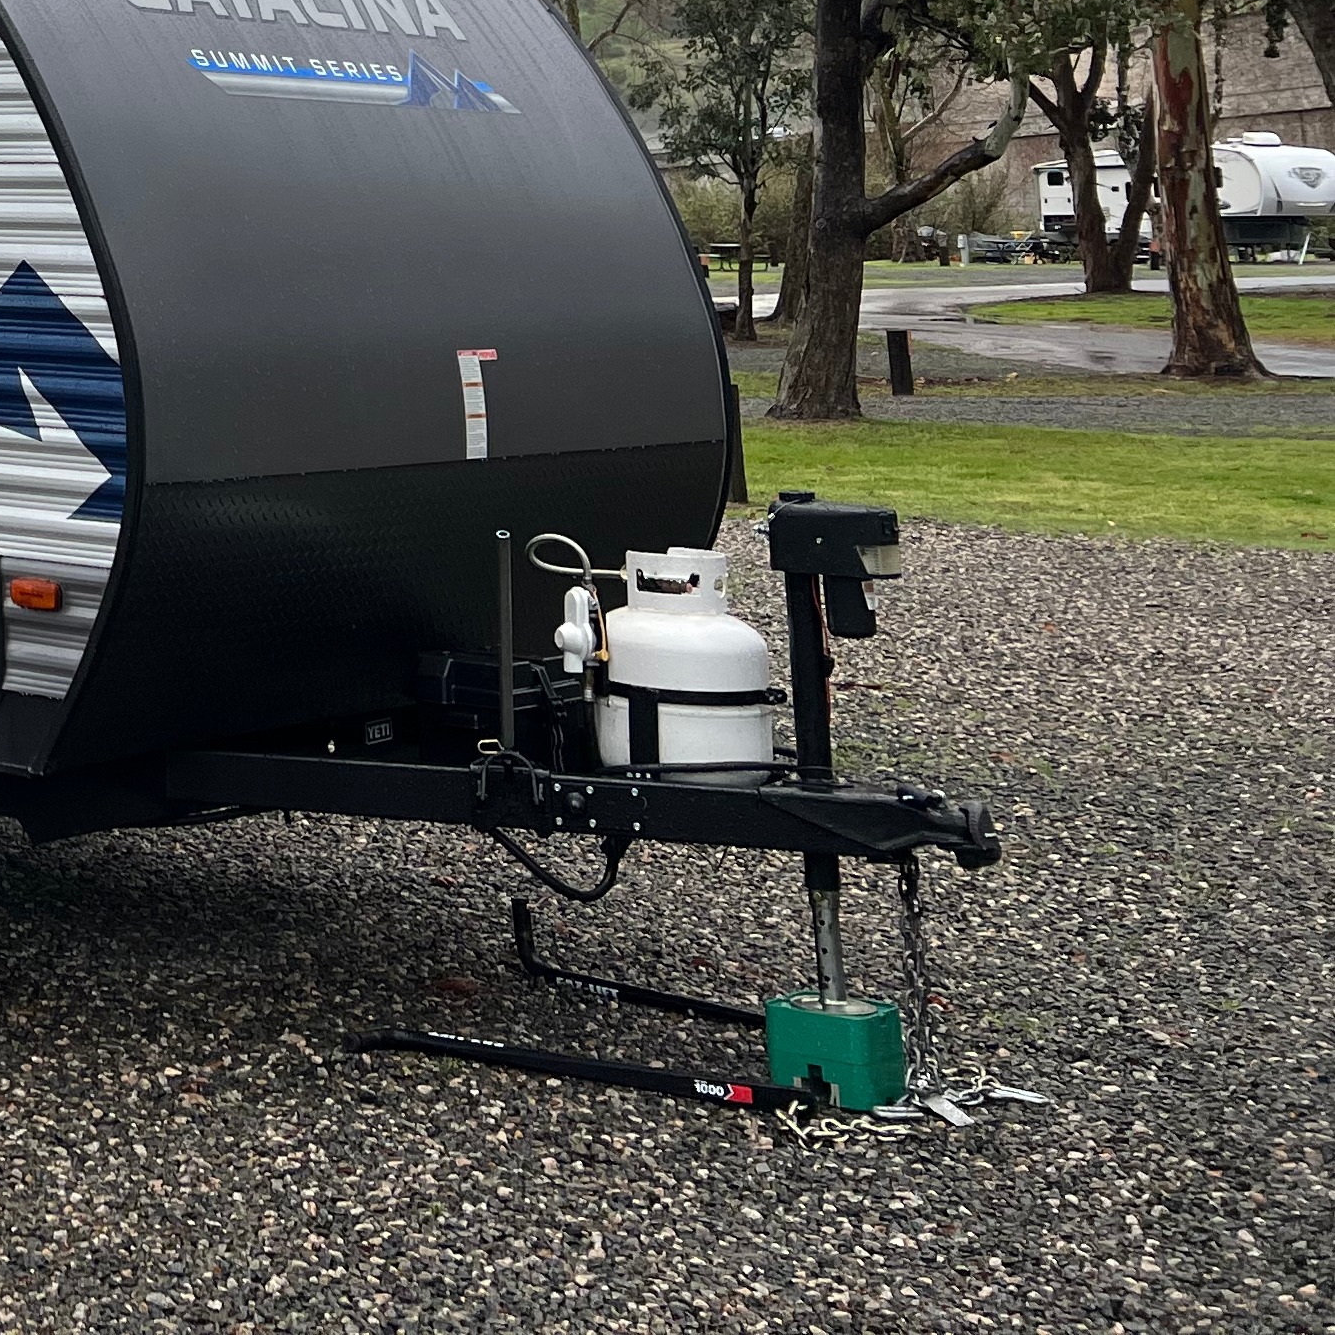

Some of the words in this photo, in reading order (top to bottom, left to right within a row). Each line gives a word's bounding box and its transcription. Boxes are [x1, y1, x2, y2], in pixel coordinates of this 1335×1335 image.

[190, 48, 298, 74] SUMMIT
[313, 58, 404, 82] SERIES
[367, 723, 390, 739] YETI
